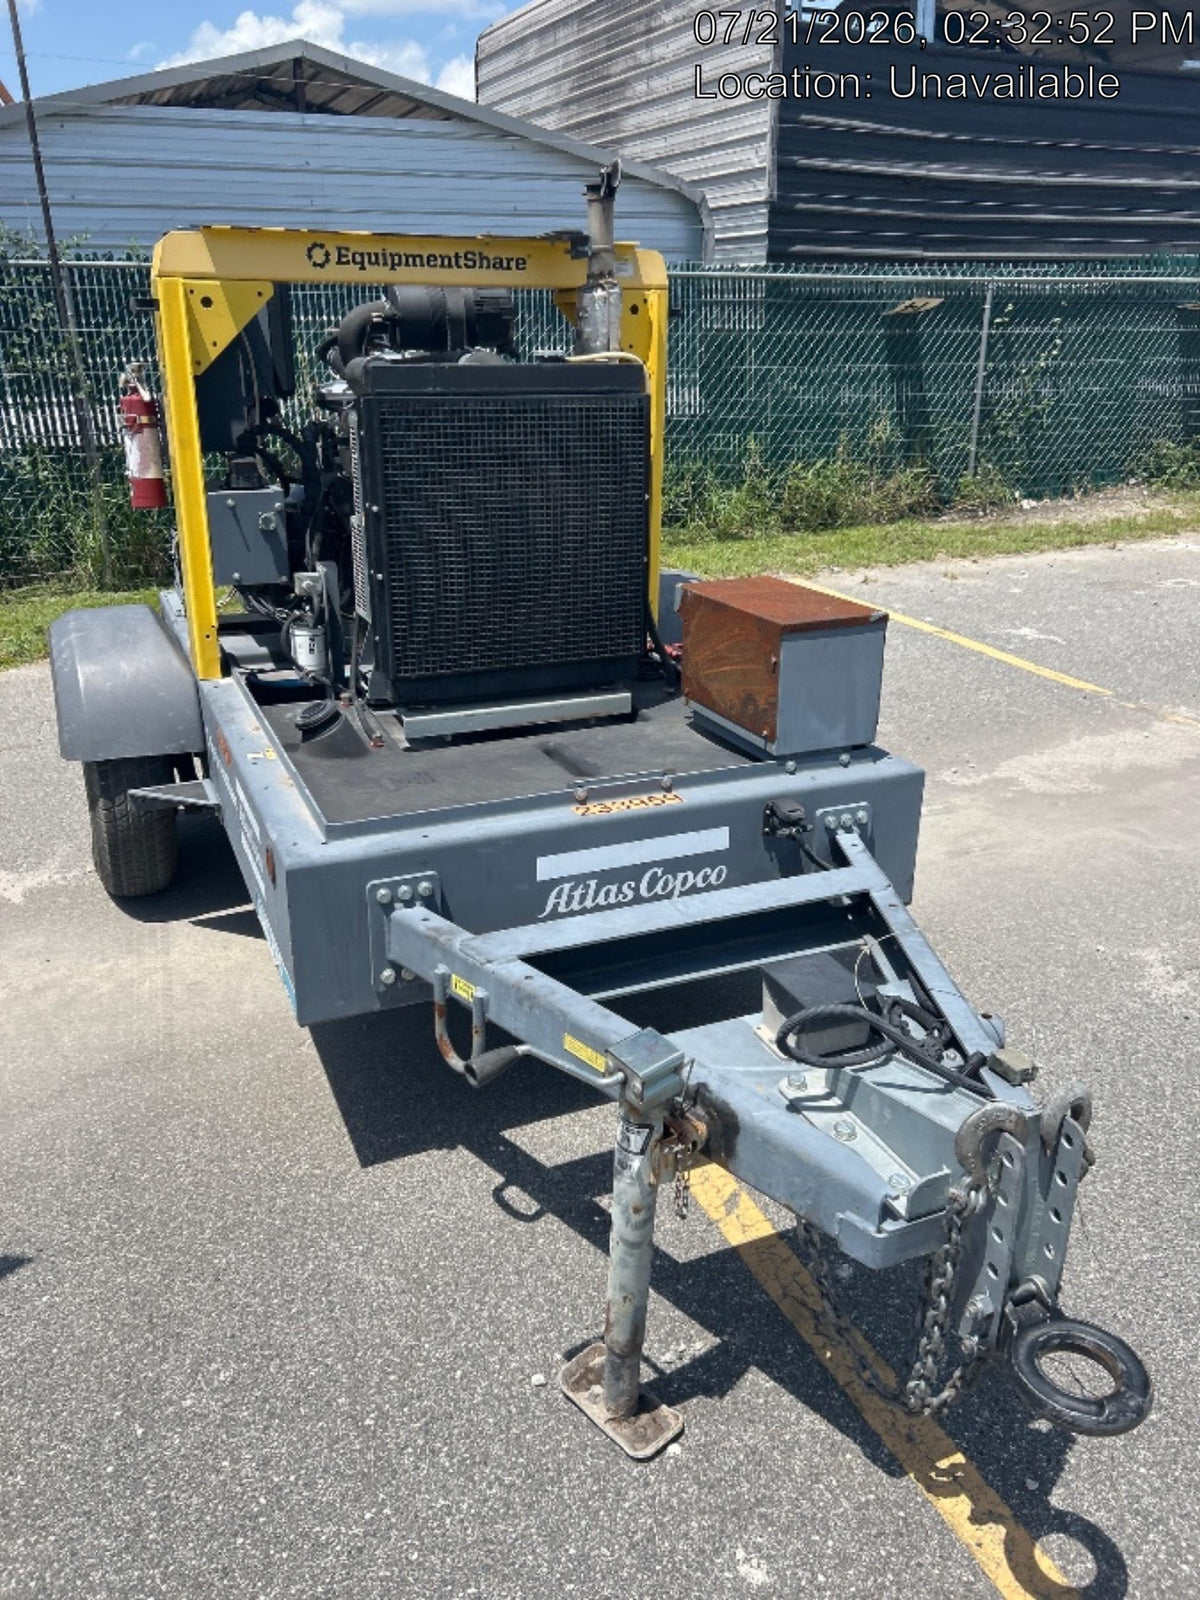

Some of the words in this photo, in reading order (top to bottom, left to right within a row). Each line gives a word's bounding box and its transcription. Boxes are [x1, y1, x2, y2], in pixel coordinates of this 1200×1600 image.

[335, 245, 528, 271] EquipmentShare
[537, 878, 636, 918] Atlas
[639, 864, 728, 901] Copco
